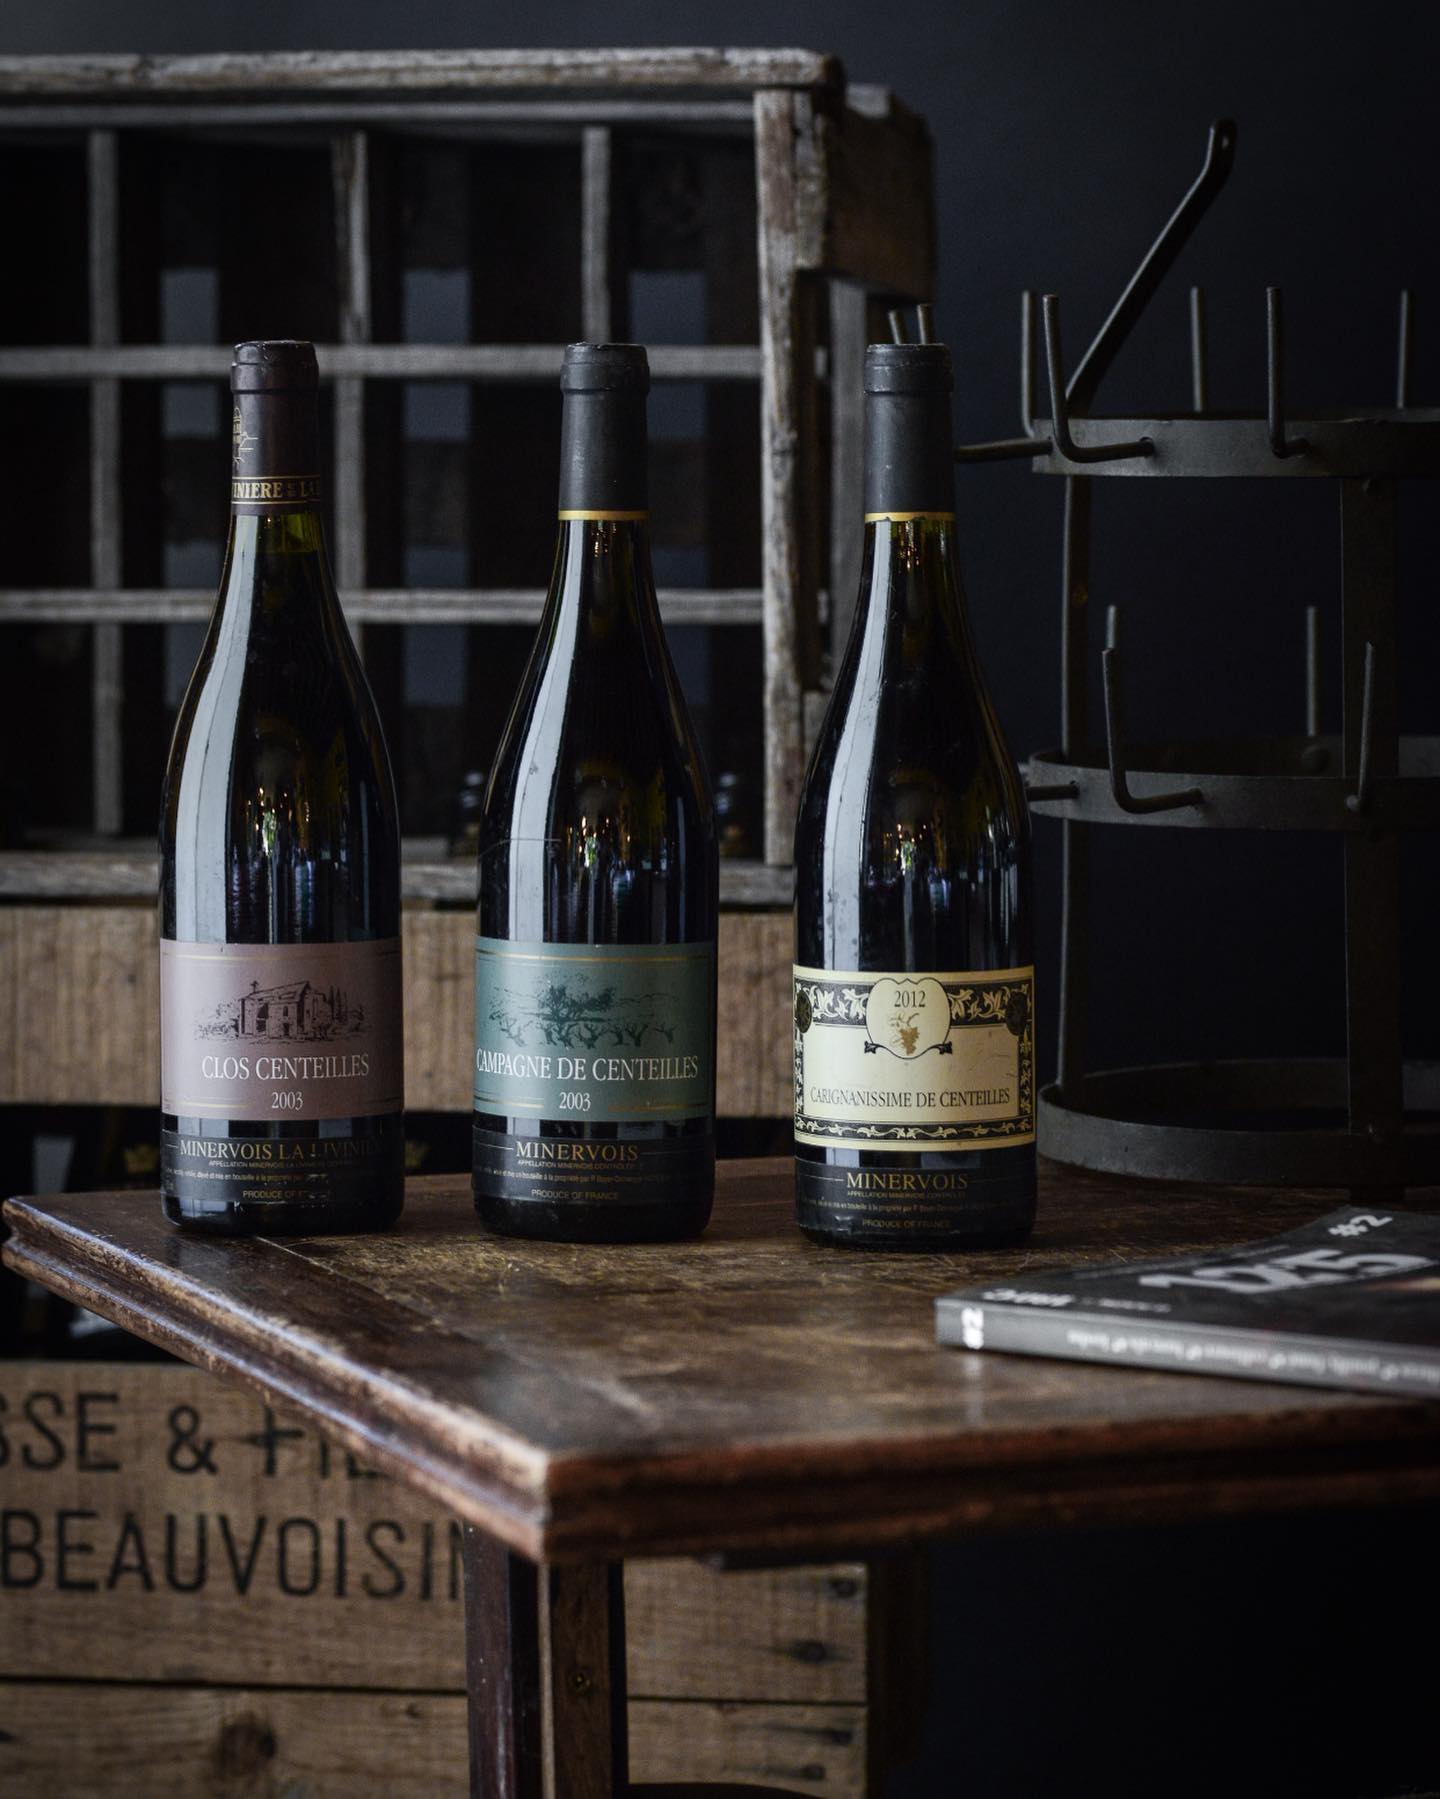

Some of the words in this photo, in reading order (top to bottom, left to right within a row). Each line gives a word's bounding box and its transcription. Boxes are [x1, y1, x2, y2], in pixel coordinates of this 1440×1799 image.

[893, 989, 926, 1008] 2012
[201, 1054, 250, 1080] CLOS
[255, 1053, 370, 1081] CENTEILLES
[476, 1047, 552, 1080] CAMPAGNE
[556, 1056, 587, 1081] DE
[592, 1055, 699, 1082] CENTEILLES
[271, 1091, 304, 1111] 2003
[559, 1091, 591, 1112] 2003
[810, 1086, 911, 1108] CARIGNANISSIME
[916, 1091, 936, 1108] DE
[940, 1087, 1010, 1108] CENTEILLES
[180, 1138, 272, 1161] MINERVOIS
[279, 1143, 304, 1161] LA
[516, 1140, 639, 1162] MINERVOIS
[846, 1171, 968, 1191] MINERVOIS
[0, 1390, 120, 1472] SE
[167, 1405, 217, 1475] &
